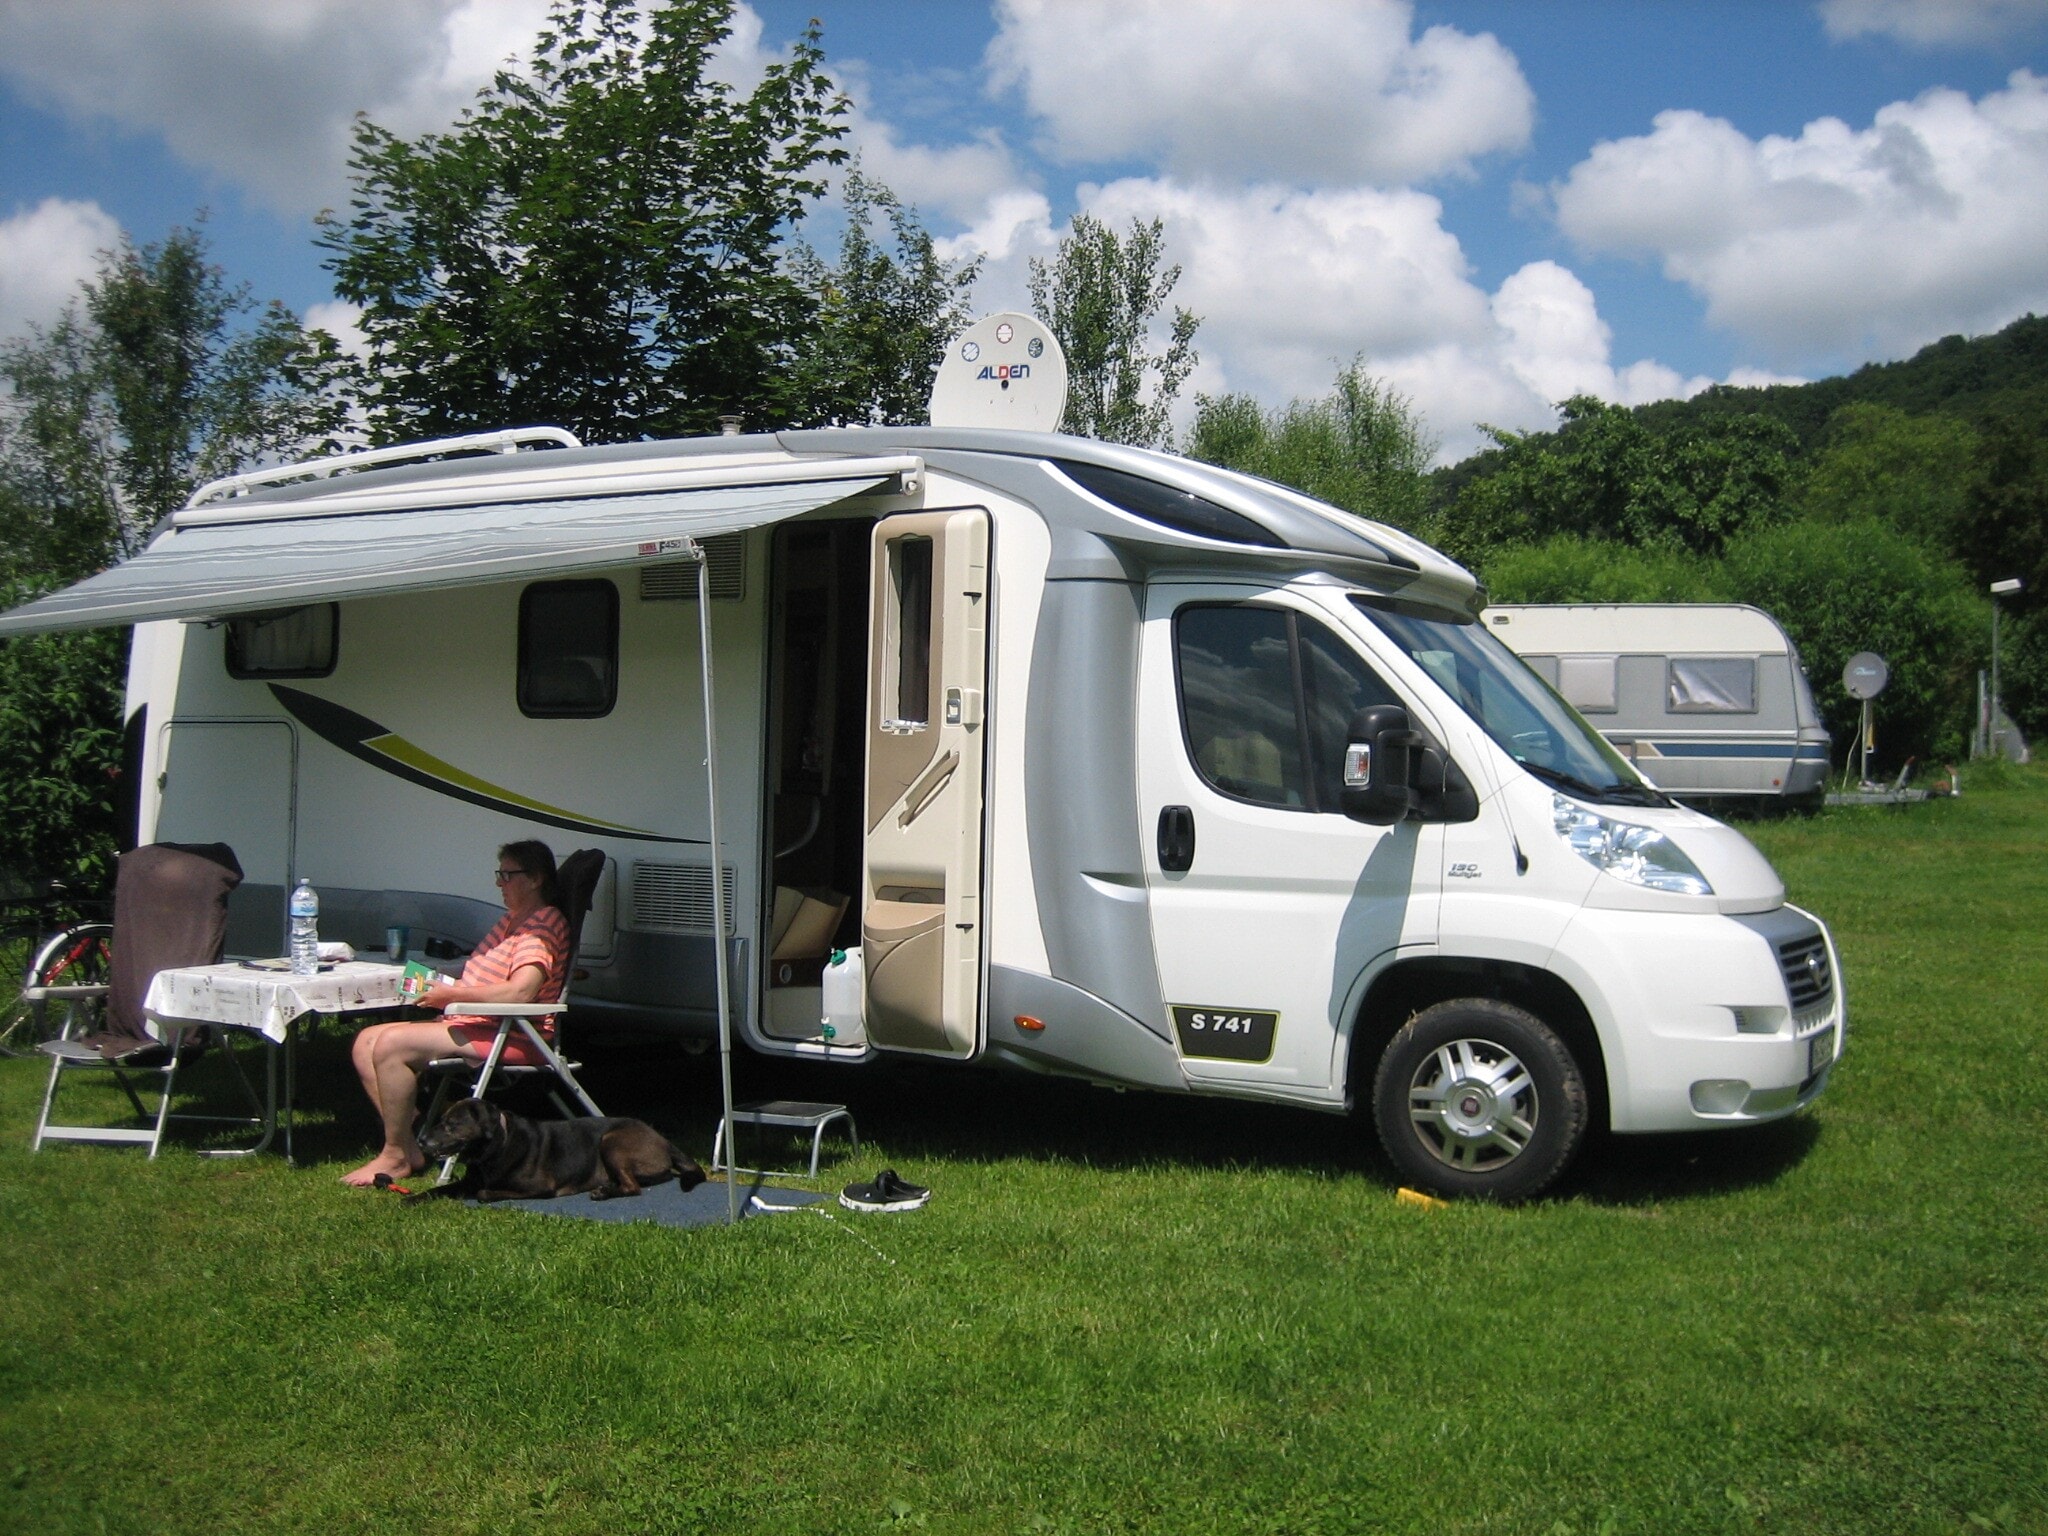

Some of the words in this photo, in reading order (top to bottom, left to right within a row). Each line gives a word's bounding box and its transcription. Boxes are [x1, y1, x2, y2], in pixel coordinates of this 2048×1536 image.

[977, 364, 1030, 380] ALDEN
[1191, 1013, 1206, 1030] S
[1213, 1015, 1252, 1034] 741
